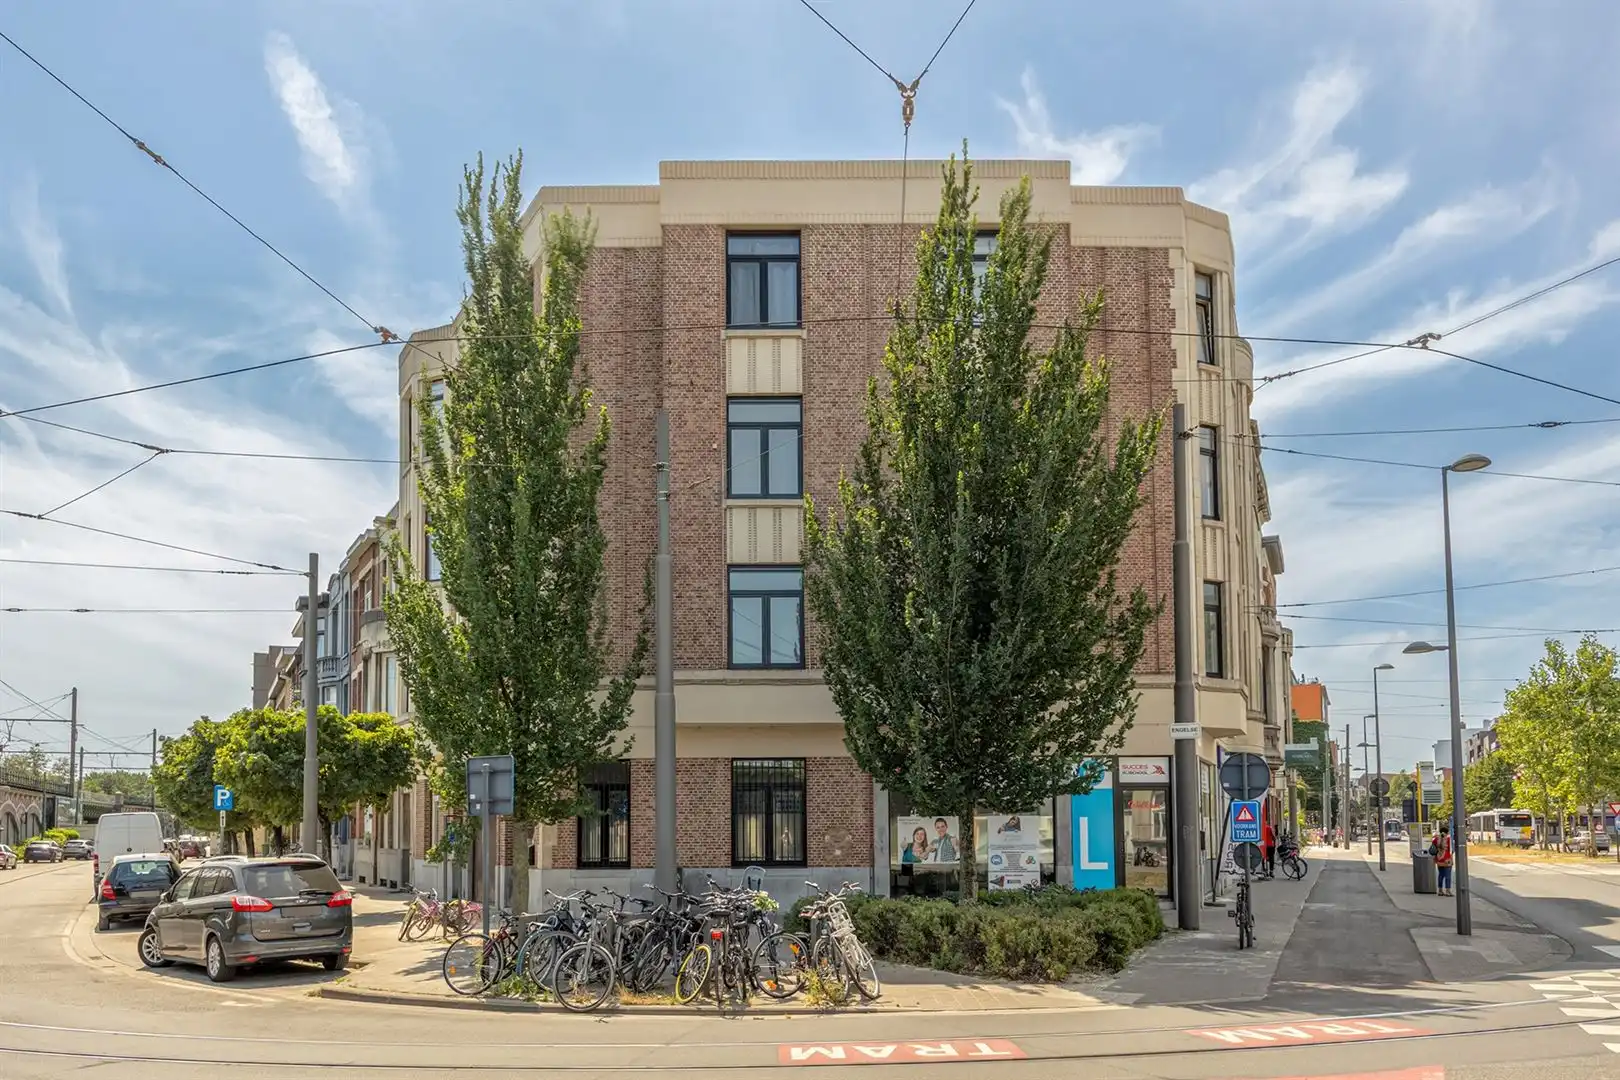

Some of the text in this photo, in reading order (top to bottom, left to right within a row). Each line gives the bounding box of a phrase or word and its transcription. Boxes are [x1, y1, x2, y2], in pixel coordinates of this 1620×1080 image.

[217, 789, 230, 807] P
[1079, 816, 1109, 870] L
[1236, 830, 1257, 838] TRAM
[1201, 1021, 1415, 1044] TRAM
[790, 1042, 1012, 1061] TRAM
